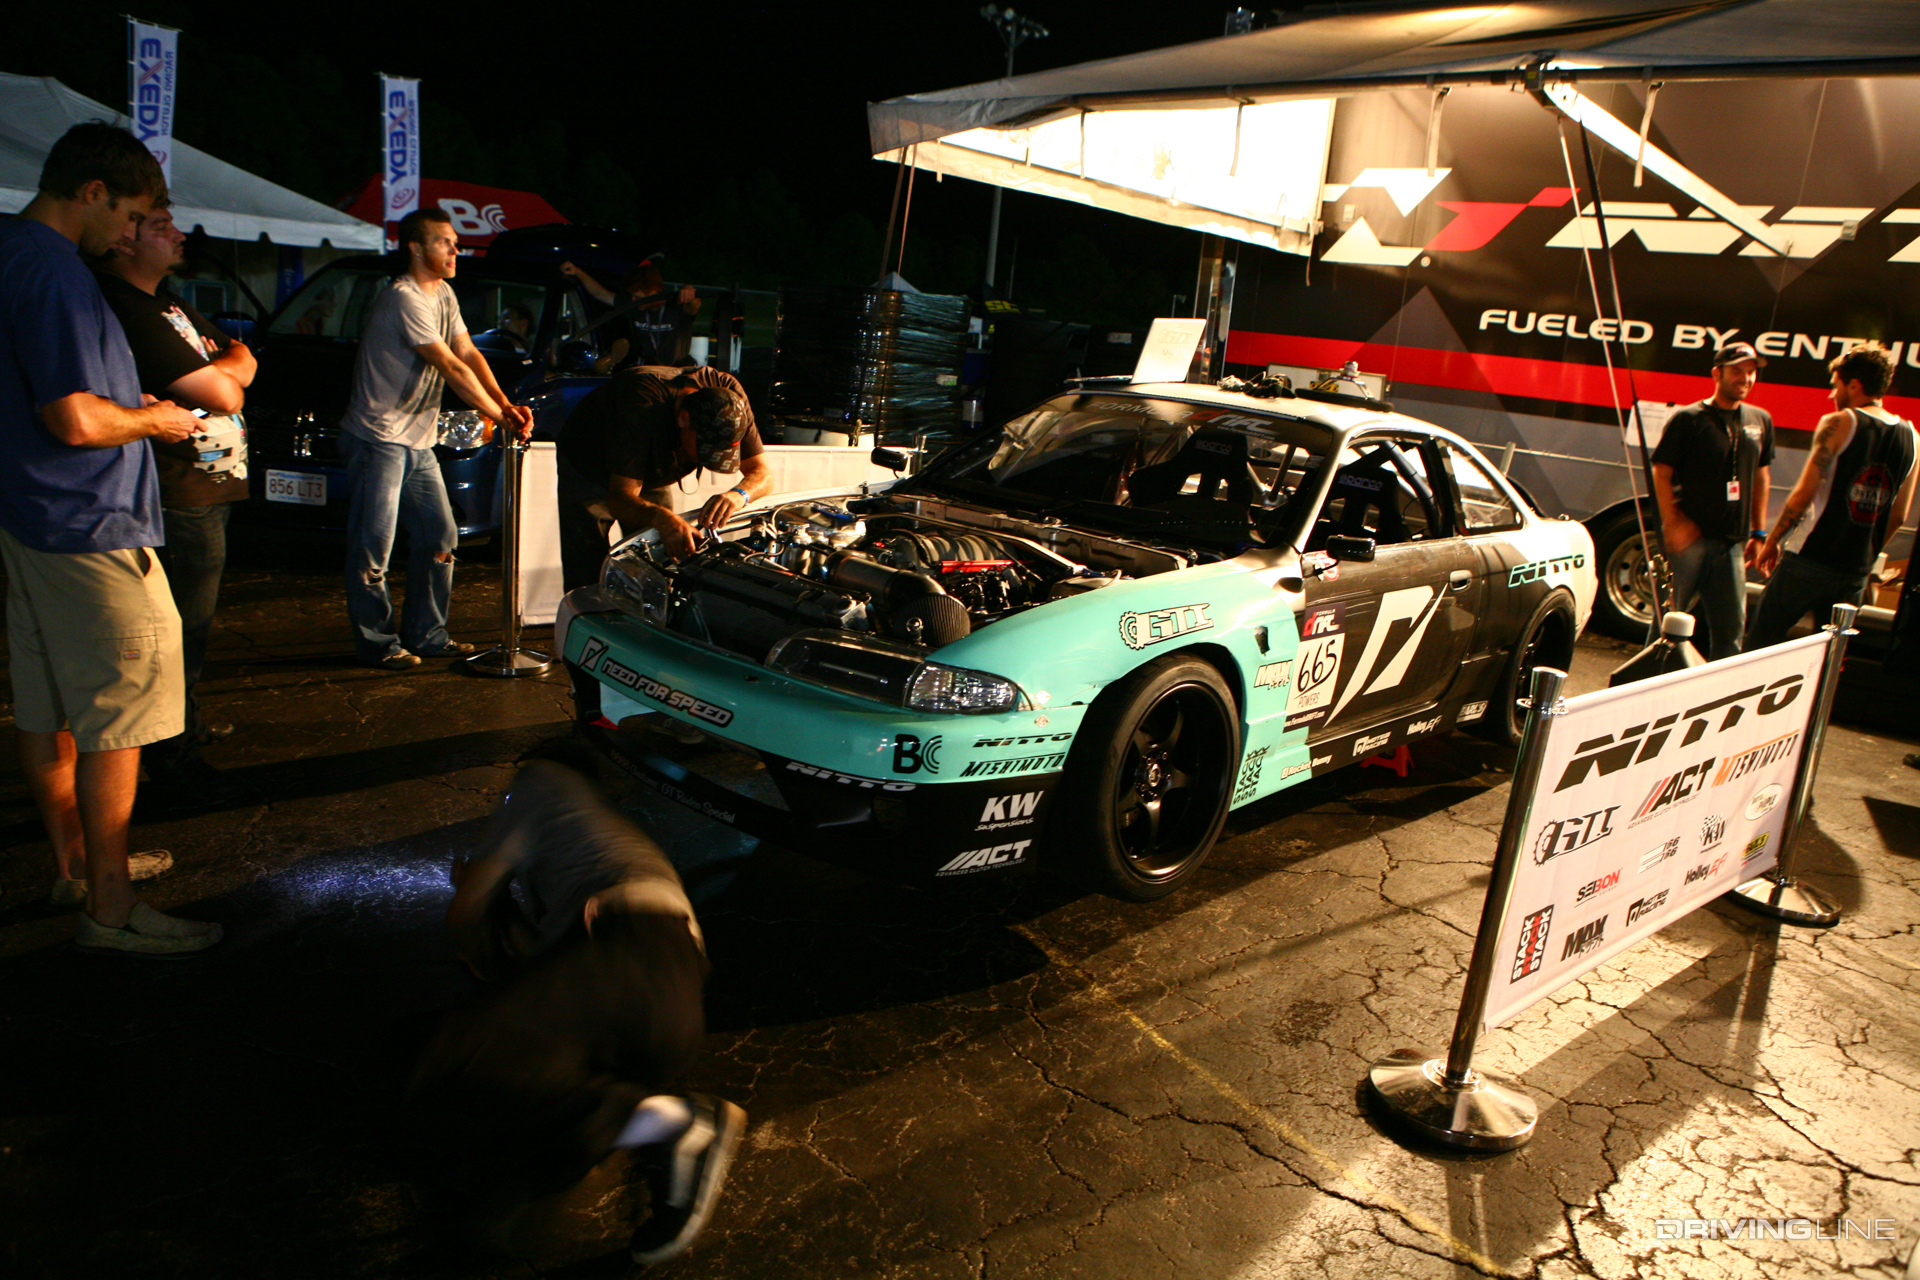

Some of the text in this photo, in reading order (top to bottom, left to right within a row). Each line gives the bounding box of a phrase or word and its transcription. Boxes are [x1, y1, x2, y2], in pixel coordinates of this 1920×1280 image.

[1479, 309, 1654, 345] FUELED
[1672, 324, 1741, 352] BY
[1085, 401, 1195, 419] FORMUA
[269, 478, 324, 498] 856 LT3
[1508, 553, 1585, 588] NITTO
[1296, 639, 1337, 696] 665
[602, 658, 733, 727] NEED FOR SPEED
[973, 732, 1073, 748] NITTO
[1553, 674, 1805, 794] NITTO
[785, 762, 917, 792] NITTO
[959, 752, 1066, 777] MISHIMOTO
[1233, 750, 1255, 804] STACK
[1241, 747, 1263, 801] STACK
[1249, 745, 1270, 797] STACK
[702, 801, 736, 824] Special
[980, 790, 1045, 822] KW
[974, 817, 1034, 831] suspensions
[935, 857, 1027, 877] ADVANCED CLUTCH TECHNOLOGY
[1576, 869, 1621, 902] SEIBON
[1512, 917, 1535, 979] STACK
[1521, 914, 1543, 976] STACK
[1530, 909, 1552, 970] STACK
